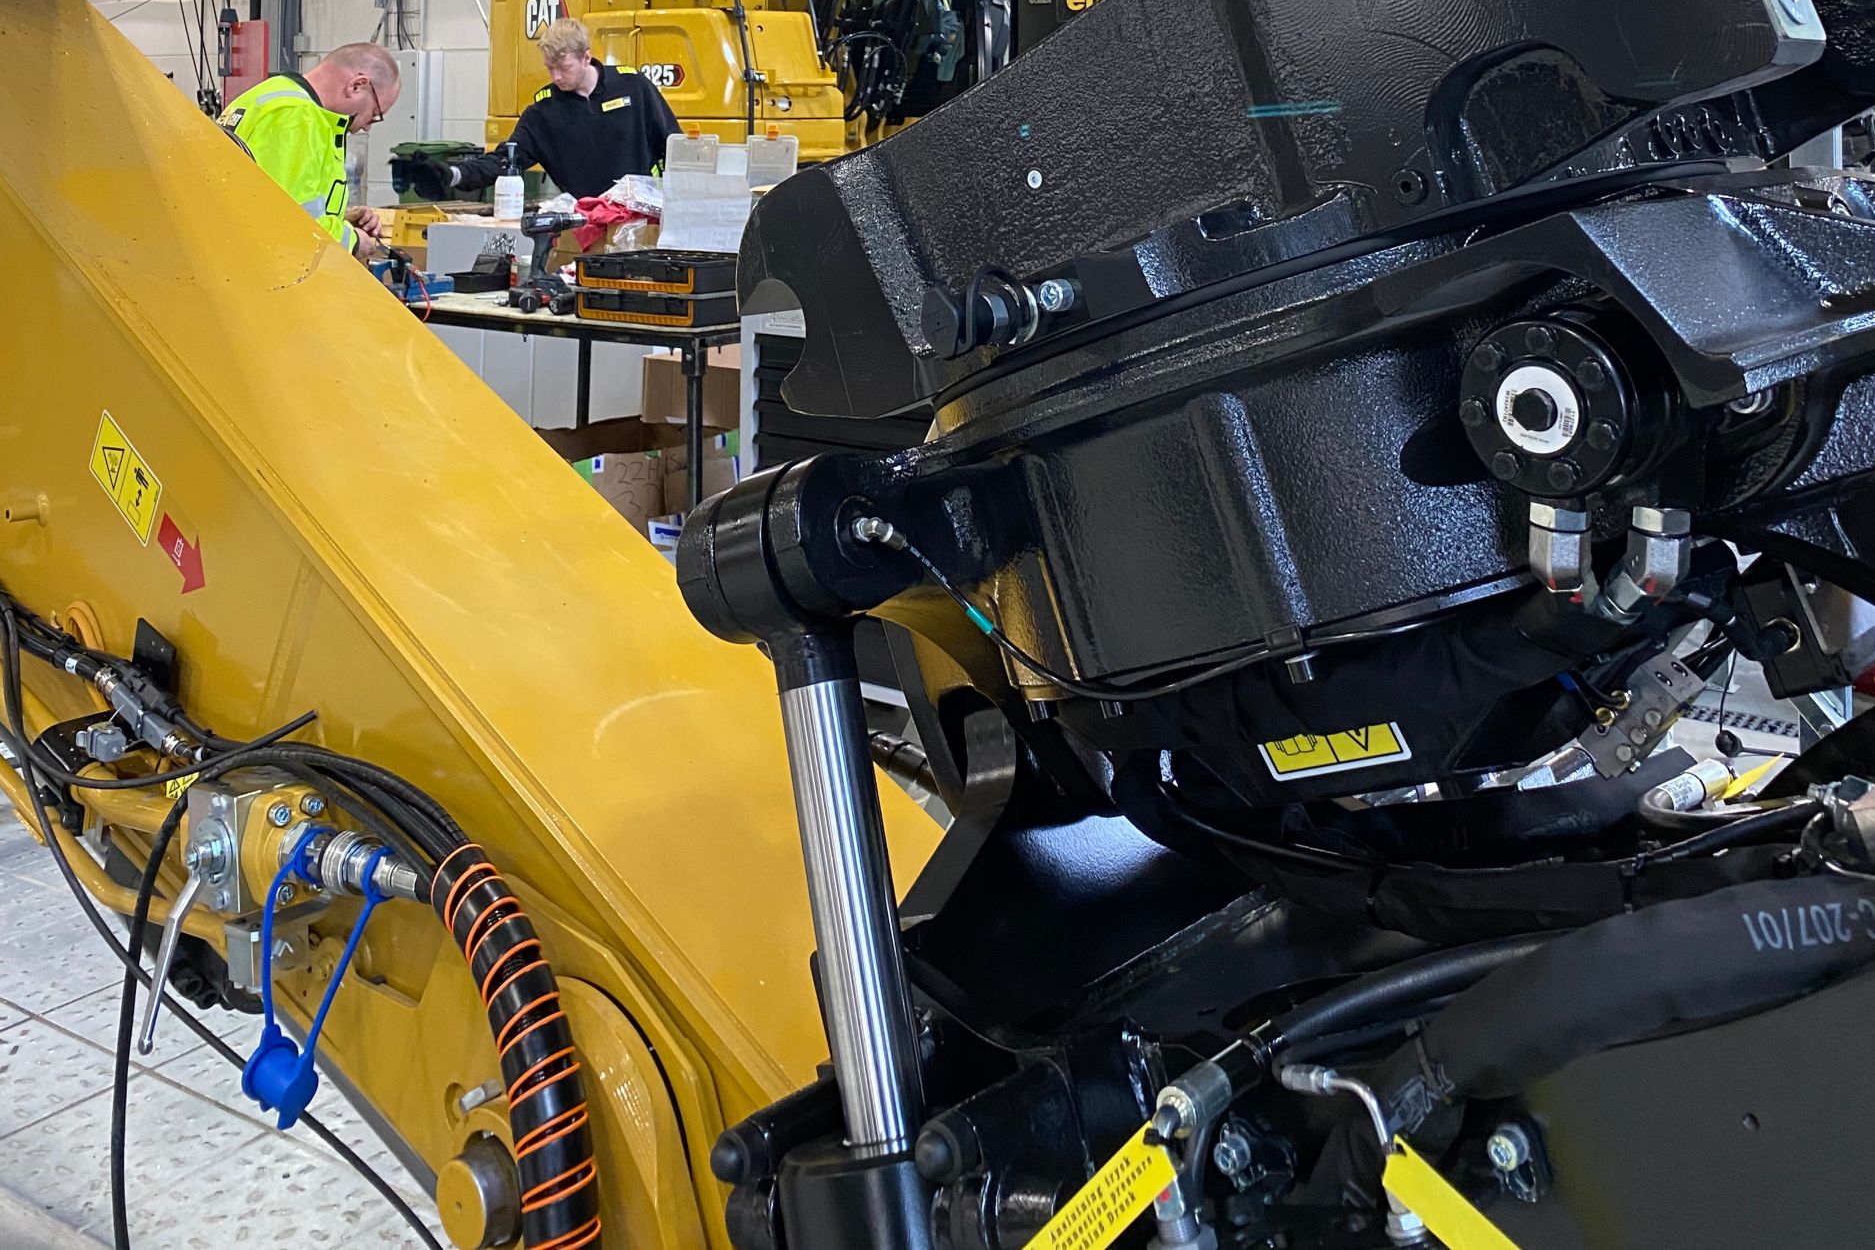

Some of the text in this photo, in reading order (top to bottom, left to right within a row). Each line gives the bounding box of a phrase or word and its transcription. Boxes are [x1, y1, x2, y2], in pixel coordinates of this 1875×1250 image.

[640, 64, 675, 86] 325
[1110, 1155, 1153, 1205] pressure
[1106, 1192, 1137, 1225] Druck
